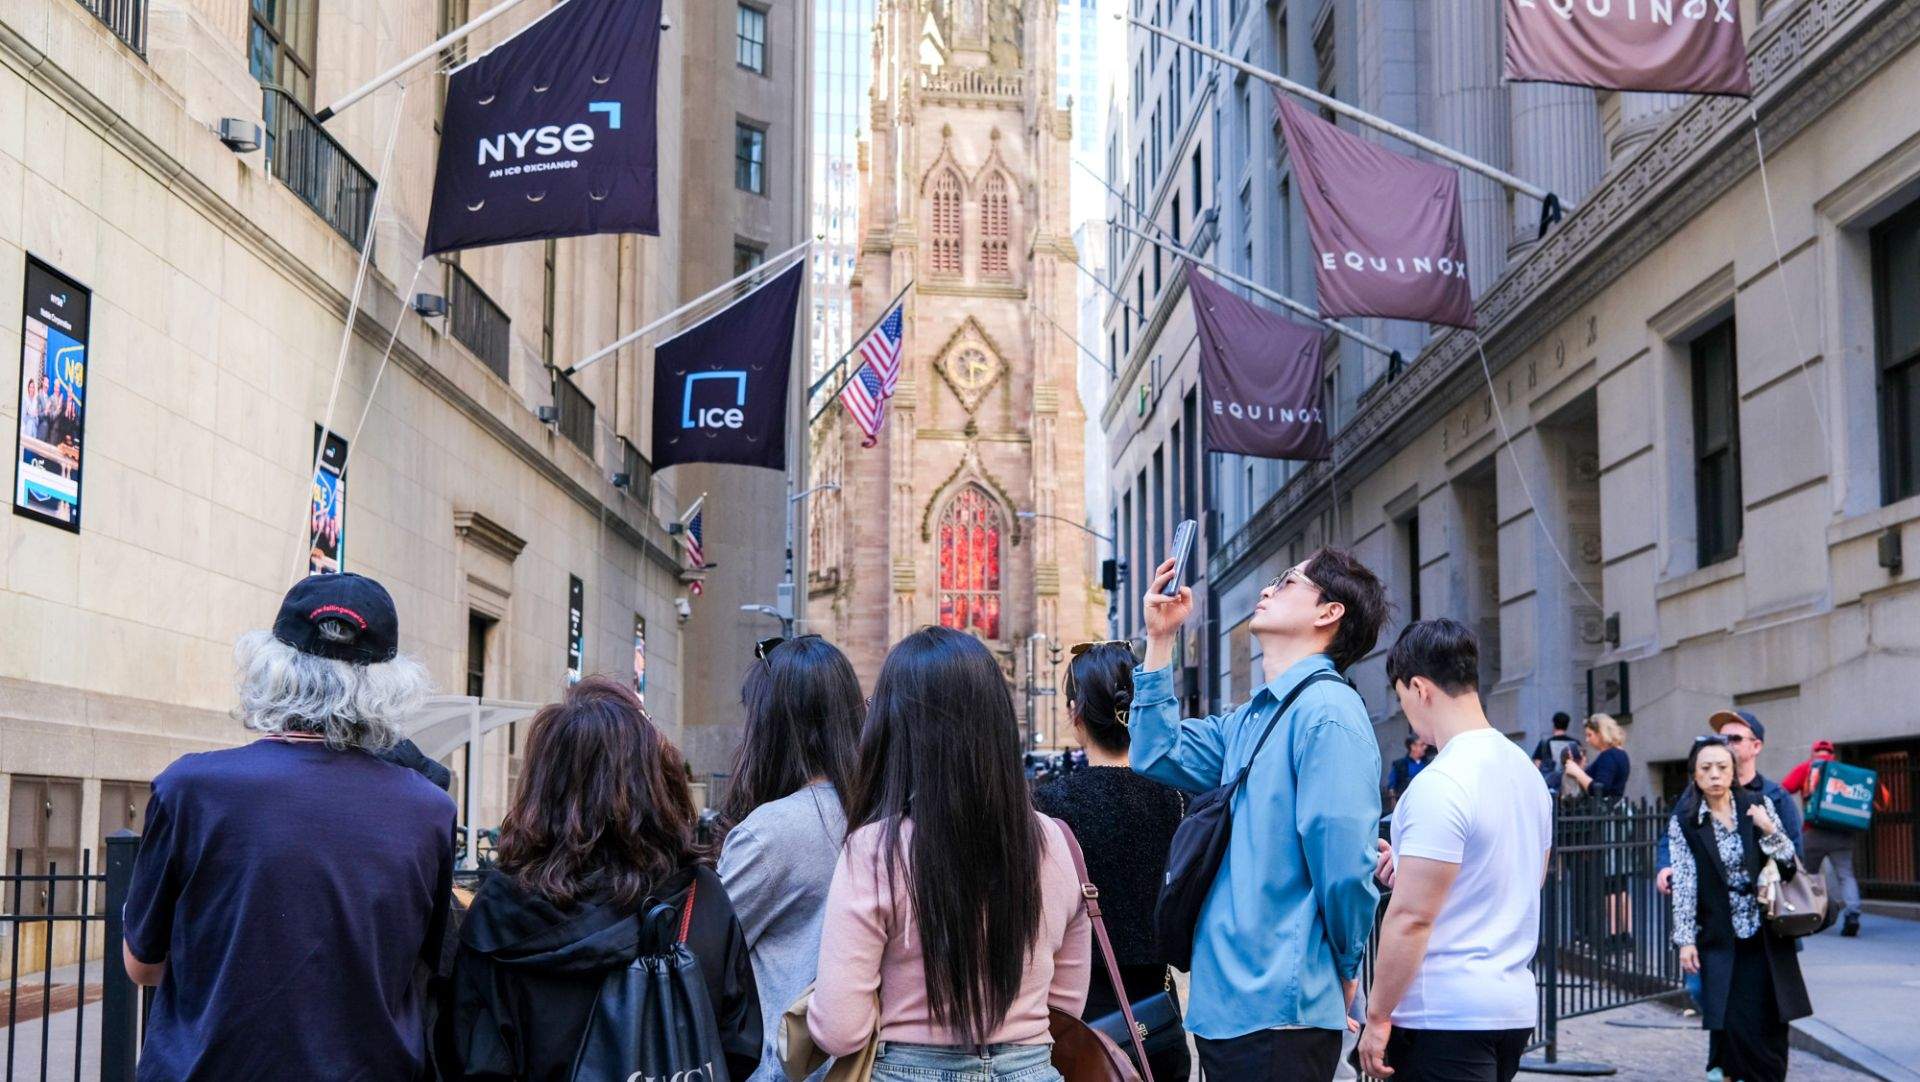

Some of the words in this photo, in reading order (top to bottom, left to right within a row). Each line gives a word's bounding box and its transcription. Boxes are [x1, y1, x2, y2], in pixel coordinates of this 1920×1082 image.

[1517, 0, 1734, 26] QUINOX
[489, 168, 503, 179] AN
[1321, 251, 1466, 279] EQUINOX
[1212, 400, 1322, 424] EQUINOX
